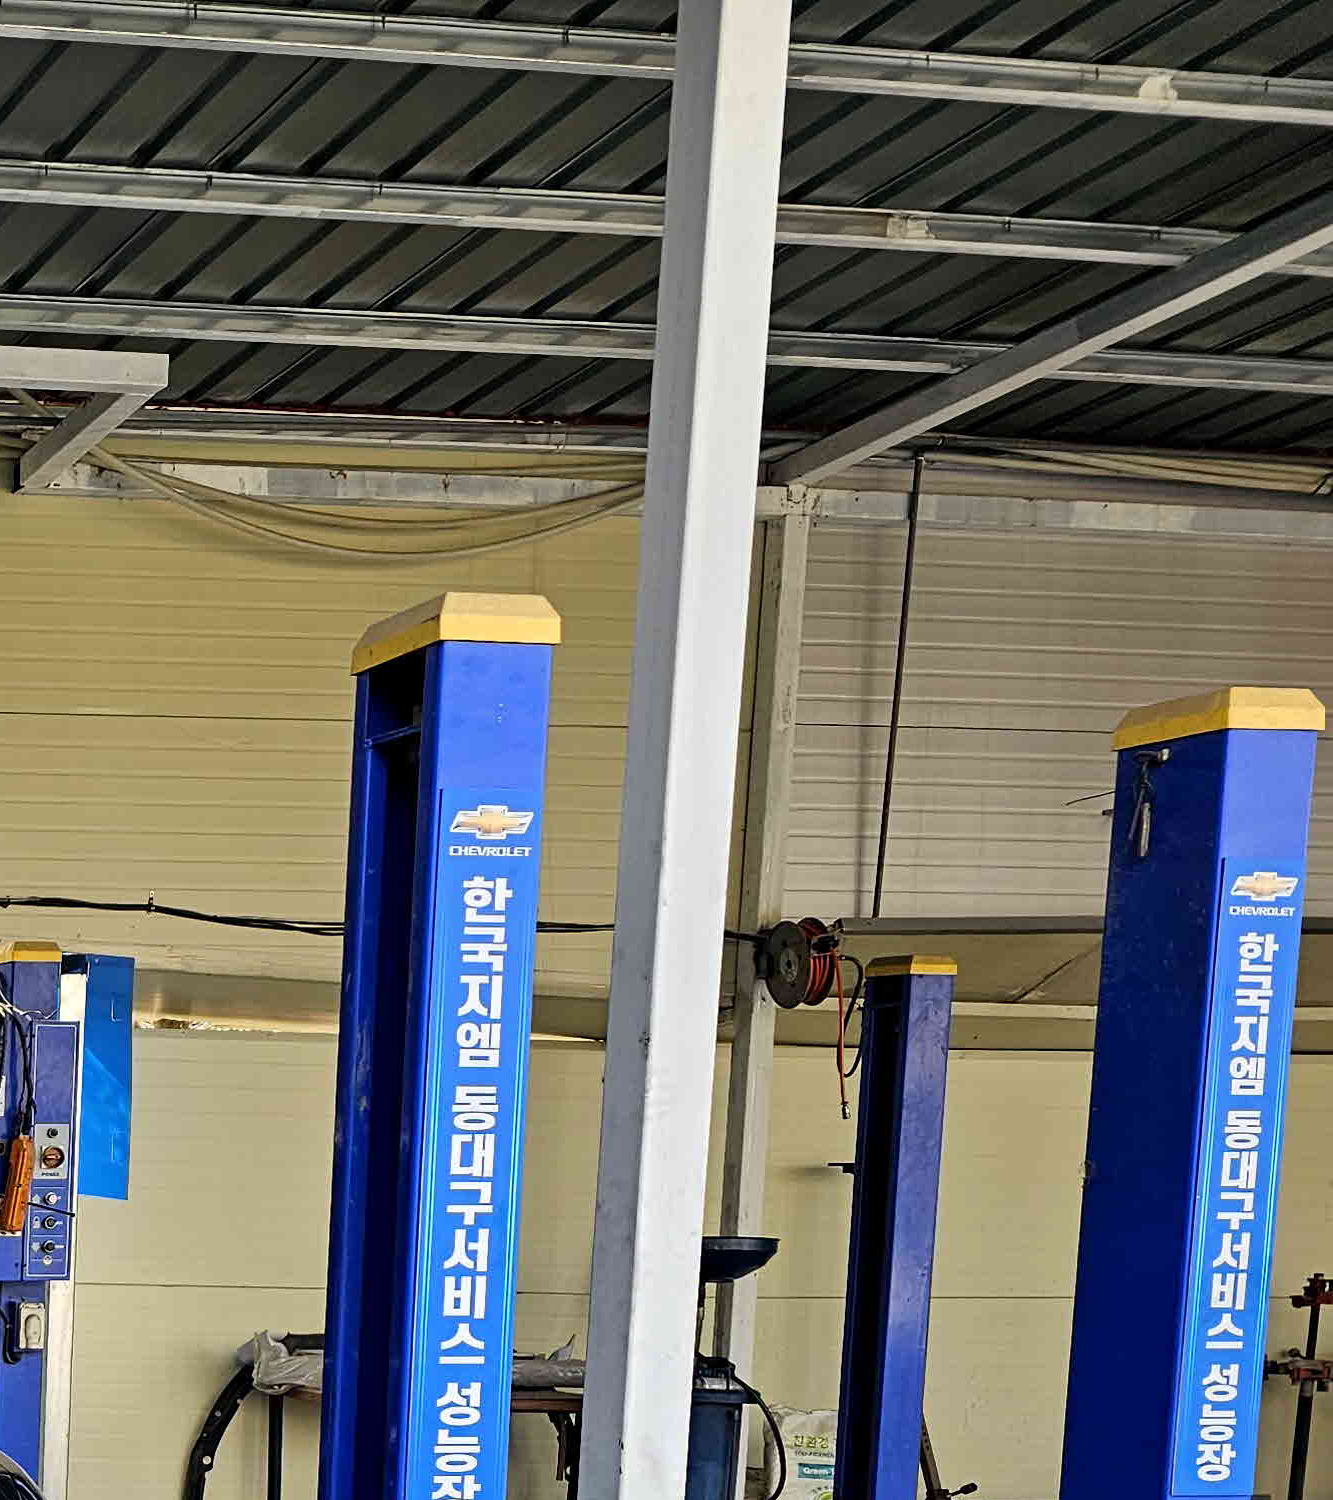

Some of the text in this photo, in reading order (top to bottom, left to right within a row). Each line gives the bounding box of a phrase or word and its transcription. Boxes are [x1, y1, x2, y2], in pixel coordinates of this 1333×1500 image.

[448, 845, 533, 857] CHEVROLET
[1229, 905, 1296, 917] CHEVROLET
[455, 875, 514, 1069] 한국지엠
[439, 1085, 500, 1366] 동대구서비스
[1195, 931, 1280, 1484] 한국지엠 동대구서비스 성능장
